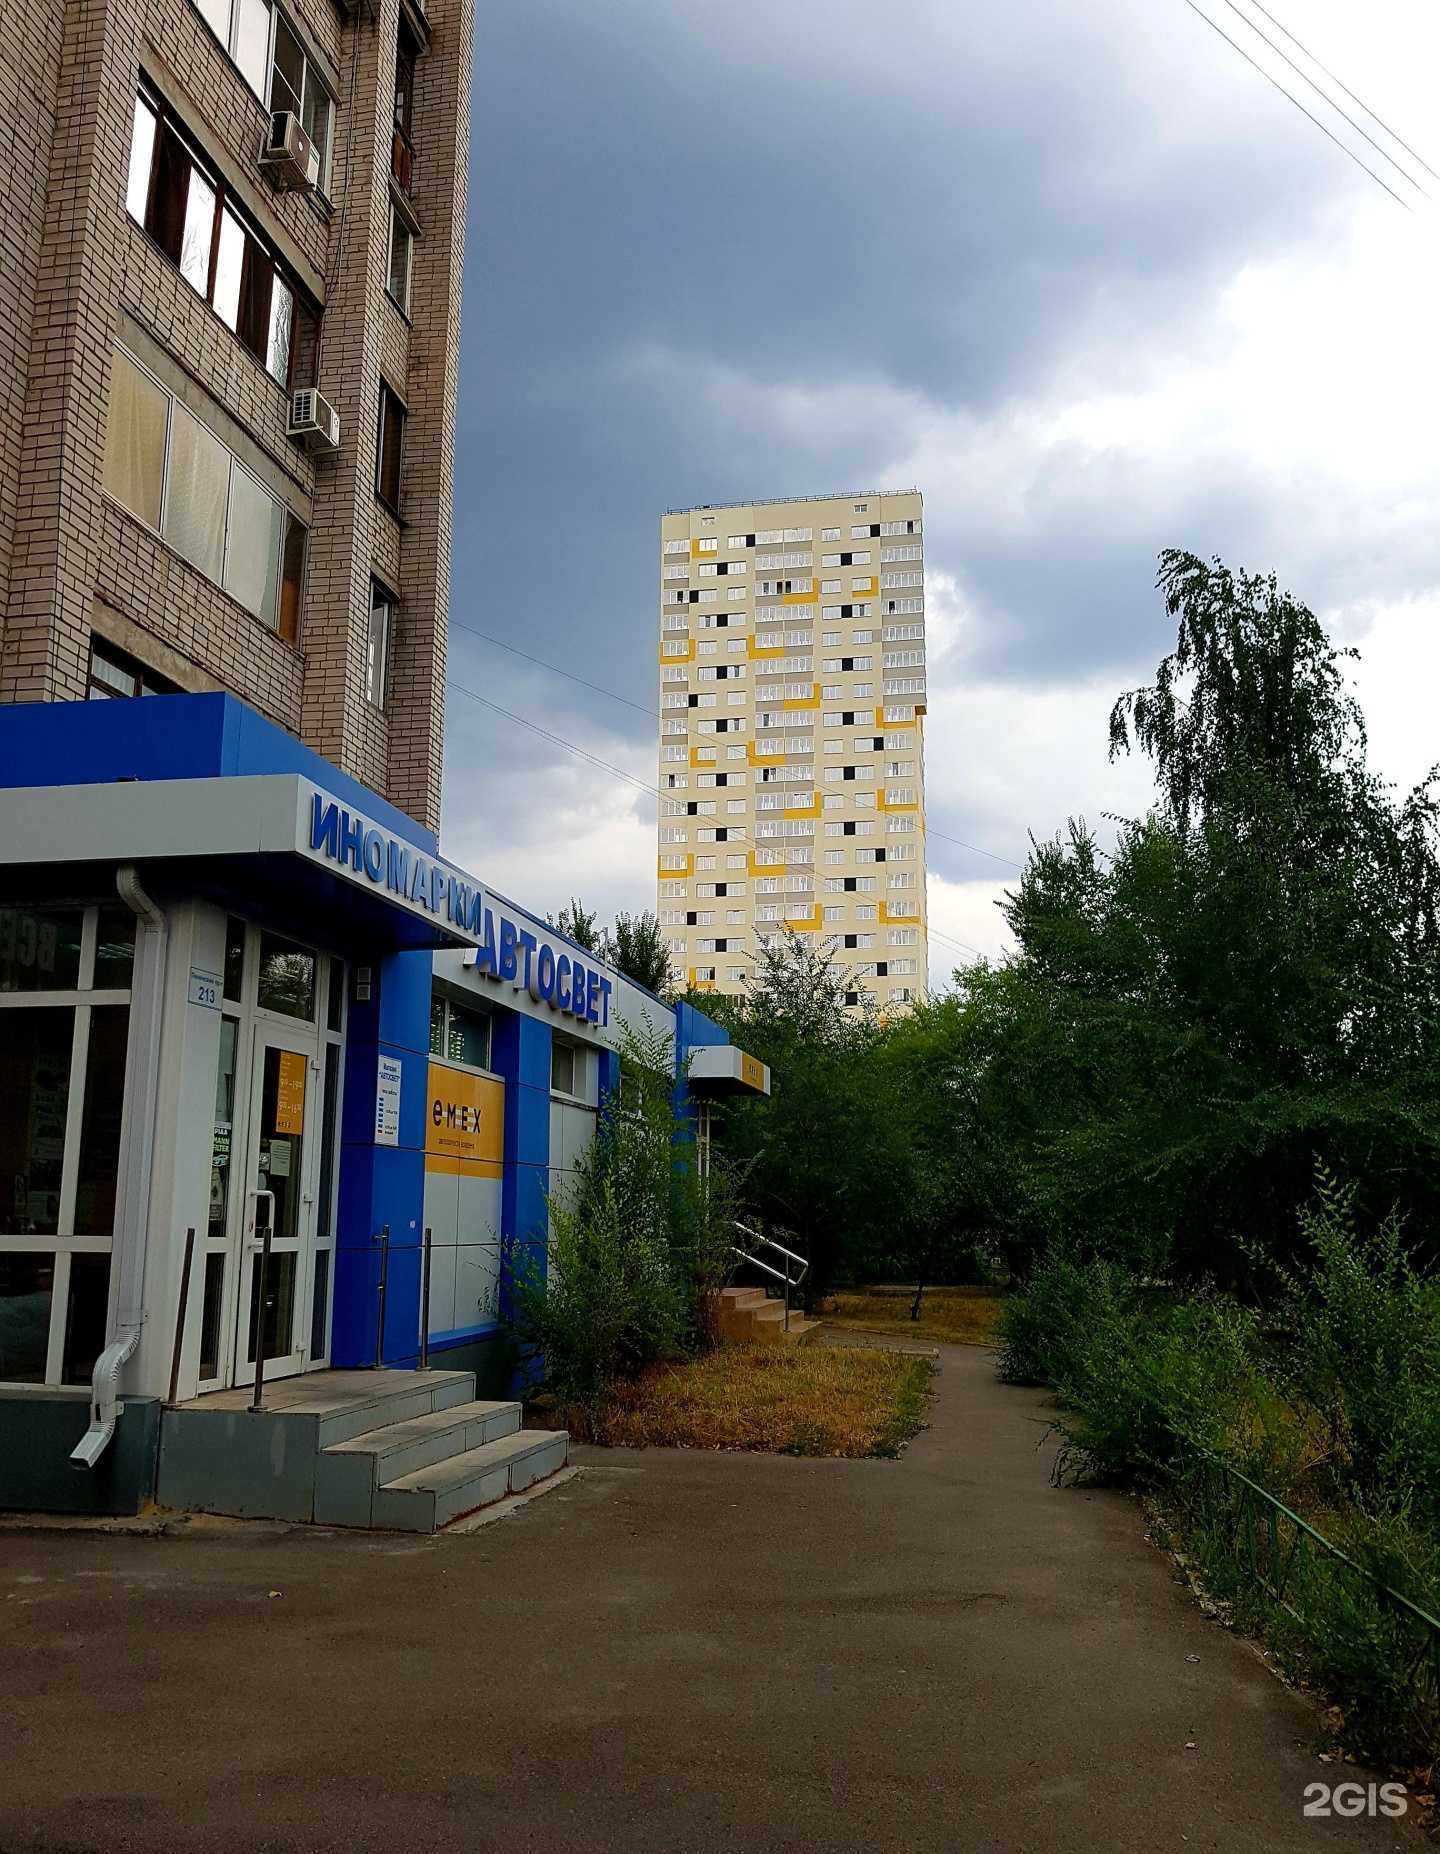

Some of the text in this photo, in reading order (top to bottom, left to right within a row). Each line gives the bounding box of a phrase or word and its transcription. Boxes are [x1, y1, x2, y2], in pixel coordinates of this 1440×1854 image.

[311, 792, 482, 936] ИНОМАРКИ
[198, 985, 216, 1004] 213
[473, 907, 613, 1028] АВТОСВЕТ
